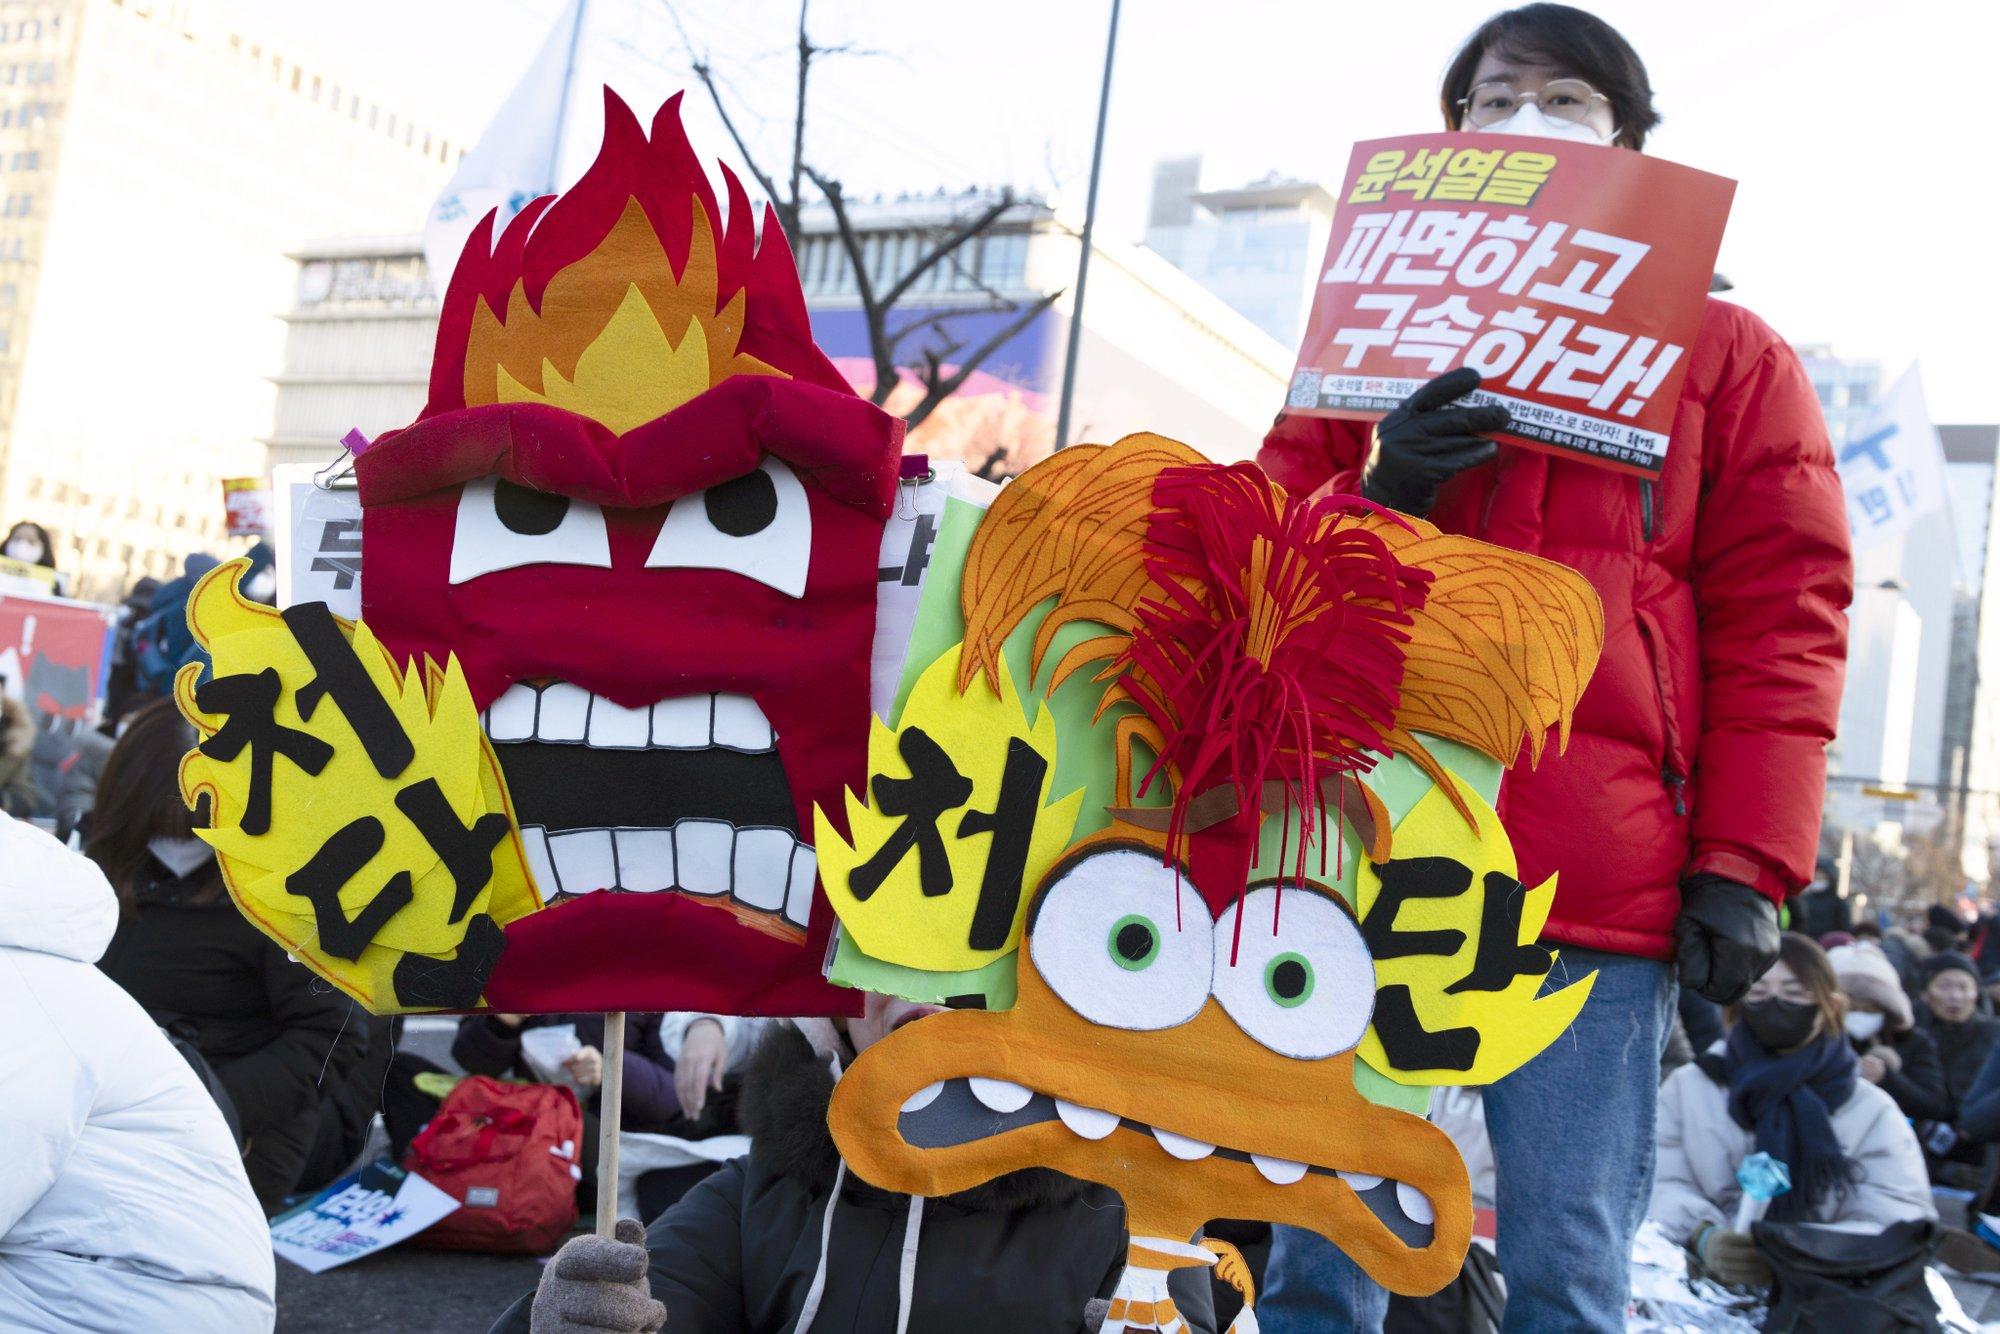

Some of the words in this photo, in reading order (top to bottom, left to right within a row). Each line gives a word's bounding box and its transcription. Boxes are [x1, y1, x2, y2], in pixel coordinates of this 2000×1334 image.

[1348, 146, 1557, 206] 윤석열을
[1323, 210, 1651, 315] 파면하고
[1332, 294, 1685, 418] 구속하라!
[1507, 400, 1577, 429] 헌법재판소로
[1579, 419, 1621, 440] 모이자!
